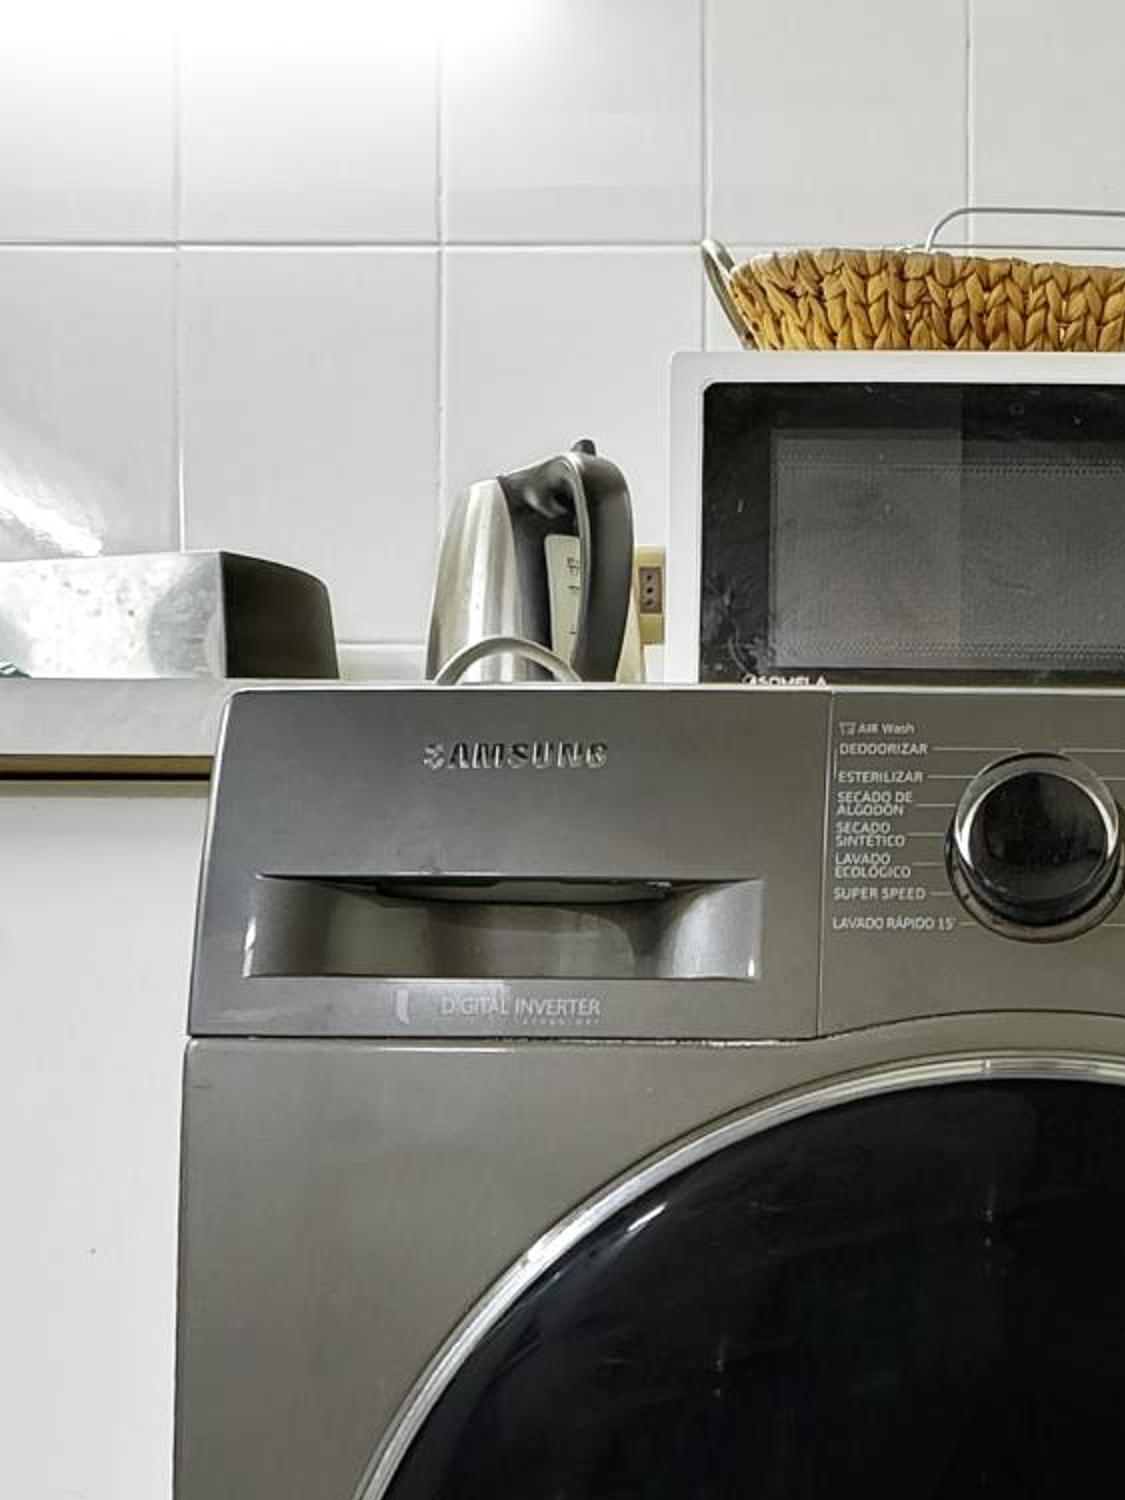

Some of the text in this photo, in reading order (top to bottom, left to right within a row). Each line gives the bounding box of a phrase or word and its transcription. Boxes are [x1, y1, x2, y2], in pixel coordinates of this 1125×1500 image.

[882, 722, 915, 734] Wash
[423, 741, 608, 770] SAMSUNG
[838, 770, 923, 783] ESTERILIZAR
[837, 790, 913, 804] SECADO DE
[835, 821, 891, 834] SECADO
[834, 852, 891, 866] LAVADO
[832, 886, 927, 900] SUPER SPEED
[832, 916, 885, 930] LAVADO
[514, 997, 601, 1016] INVERTER
